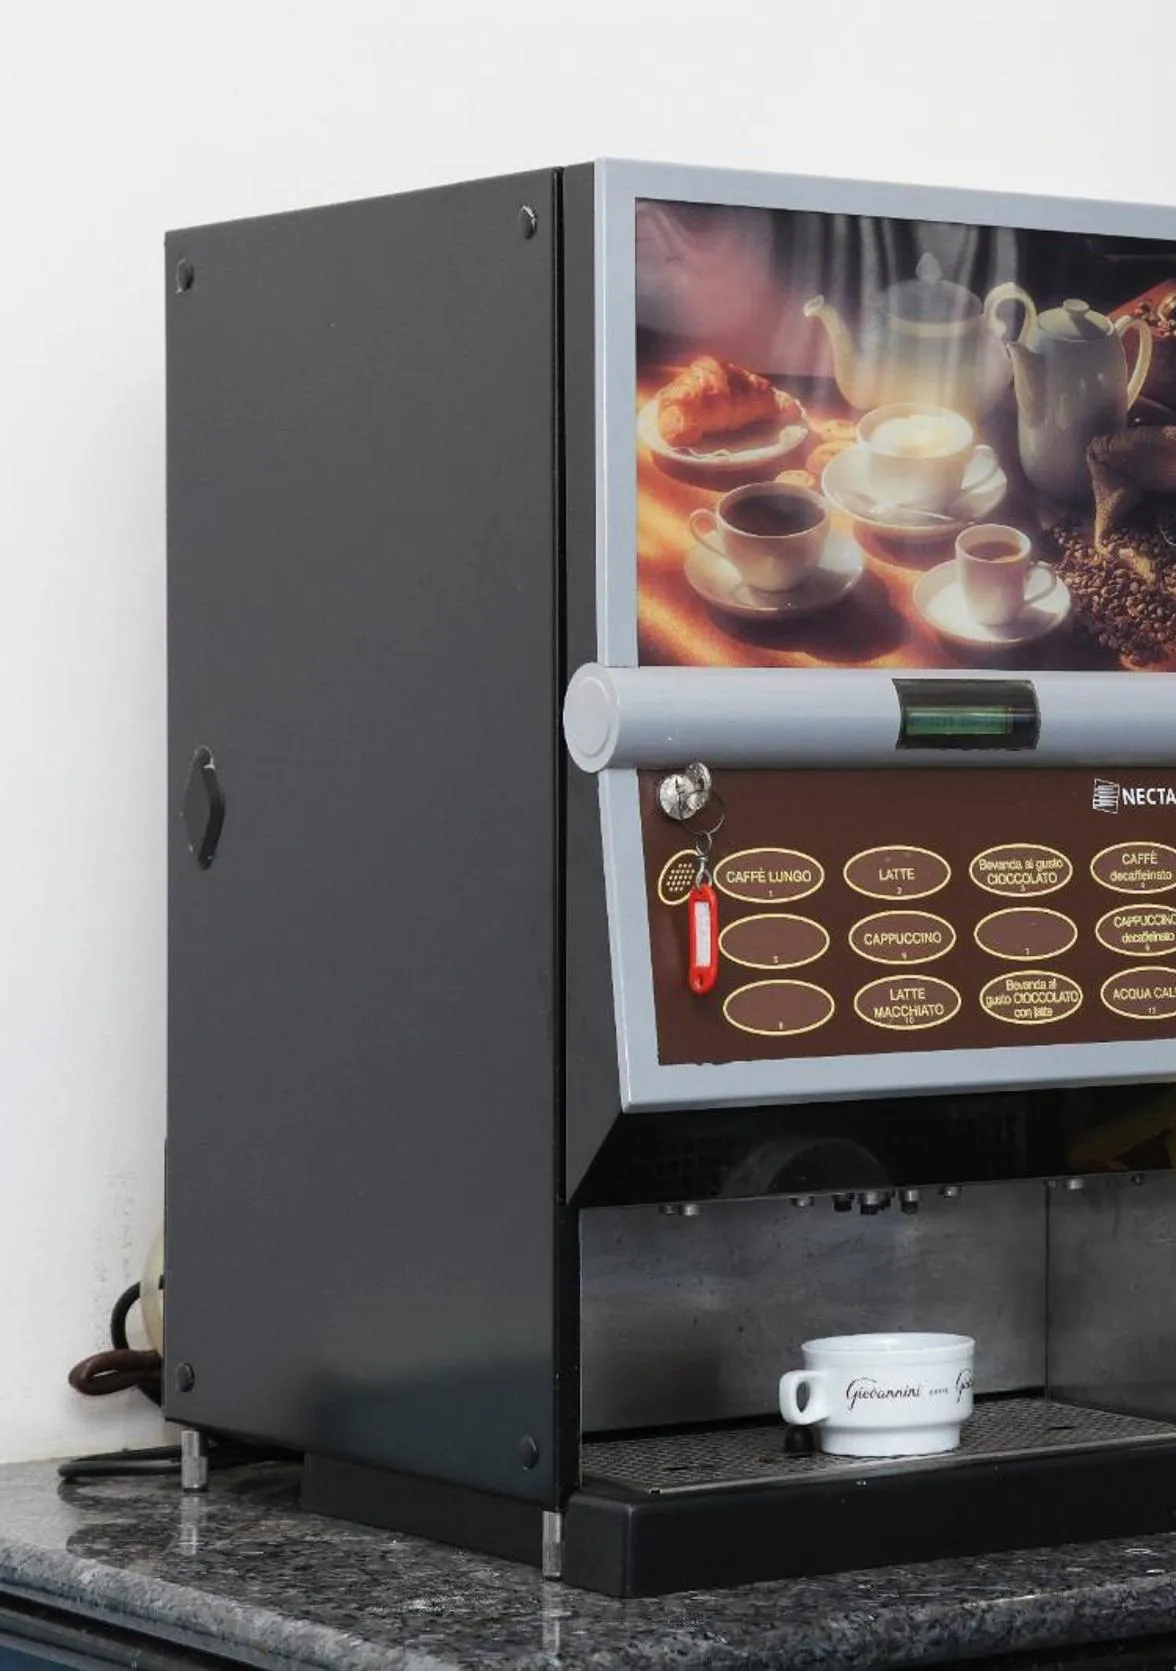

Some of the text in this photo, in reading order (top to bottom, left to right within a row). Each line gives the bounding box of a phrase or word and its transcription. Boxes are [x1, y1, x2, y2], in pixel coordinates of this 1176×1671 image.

[1121, 849, 1158, 865] CAFFÈ
[978, 858, 1063, 872] Bevanda al gusto
[726, 867, 812, 883] CAFFÈ LUNGO
[878, 867, 915, 881] LATTE
[987, 872, 1058, 885] CIOCCOLATO
[1110, 869, 1172, 882] decaffeinato
[863, 931, 942, 945] CAPPUCCINO
[1121, 930, 1176, 943] decaffeinato
[1006, 978, 1057, 991] Bevanda al
[889, 987, 926, 1001] LATTE
[985, 991, 1079, 1008] gusto CIOCCOLATO
[1112, 987, 1152, 1002] ACQUA
[874, 1004, 945, 1019] MACCHIATO
[1014, 1007, 1032, 1019] con
